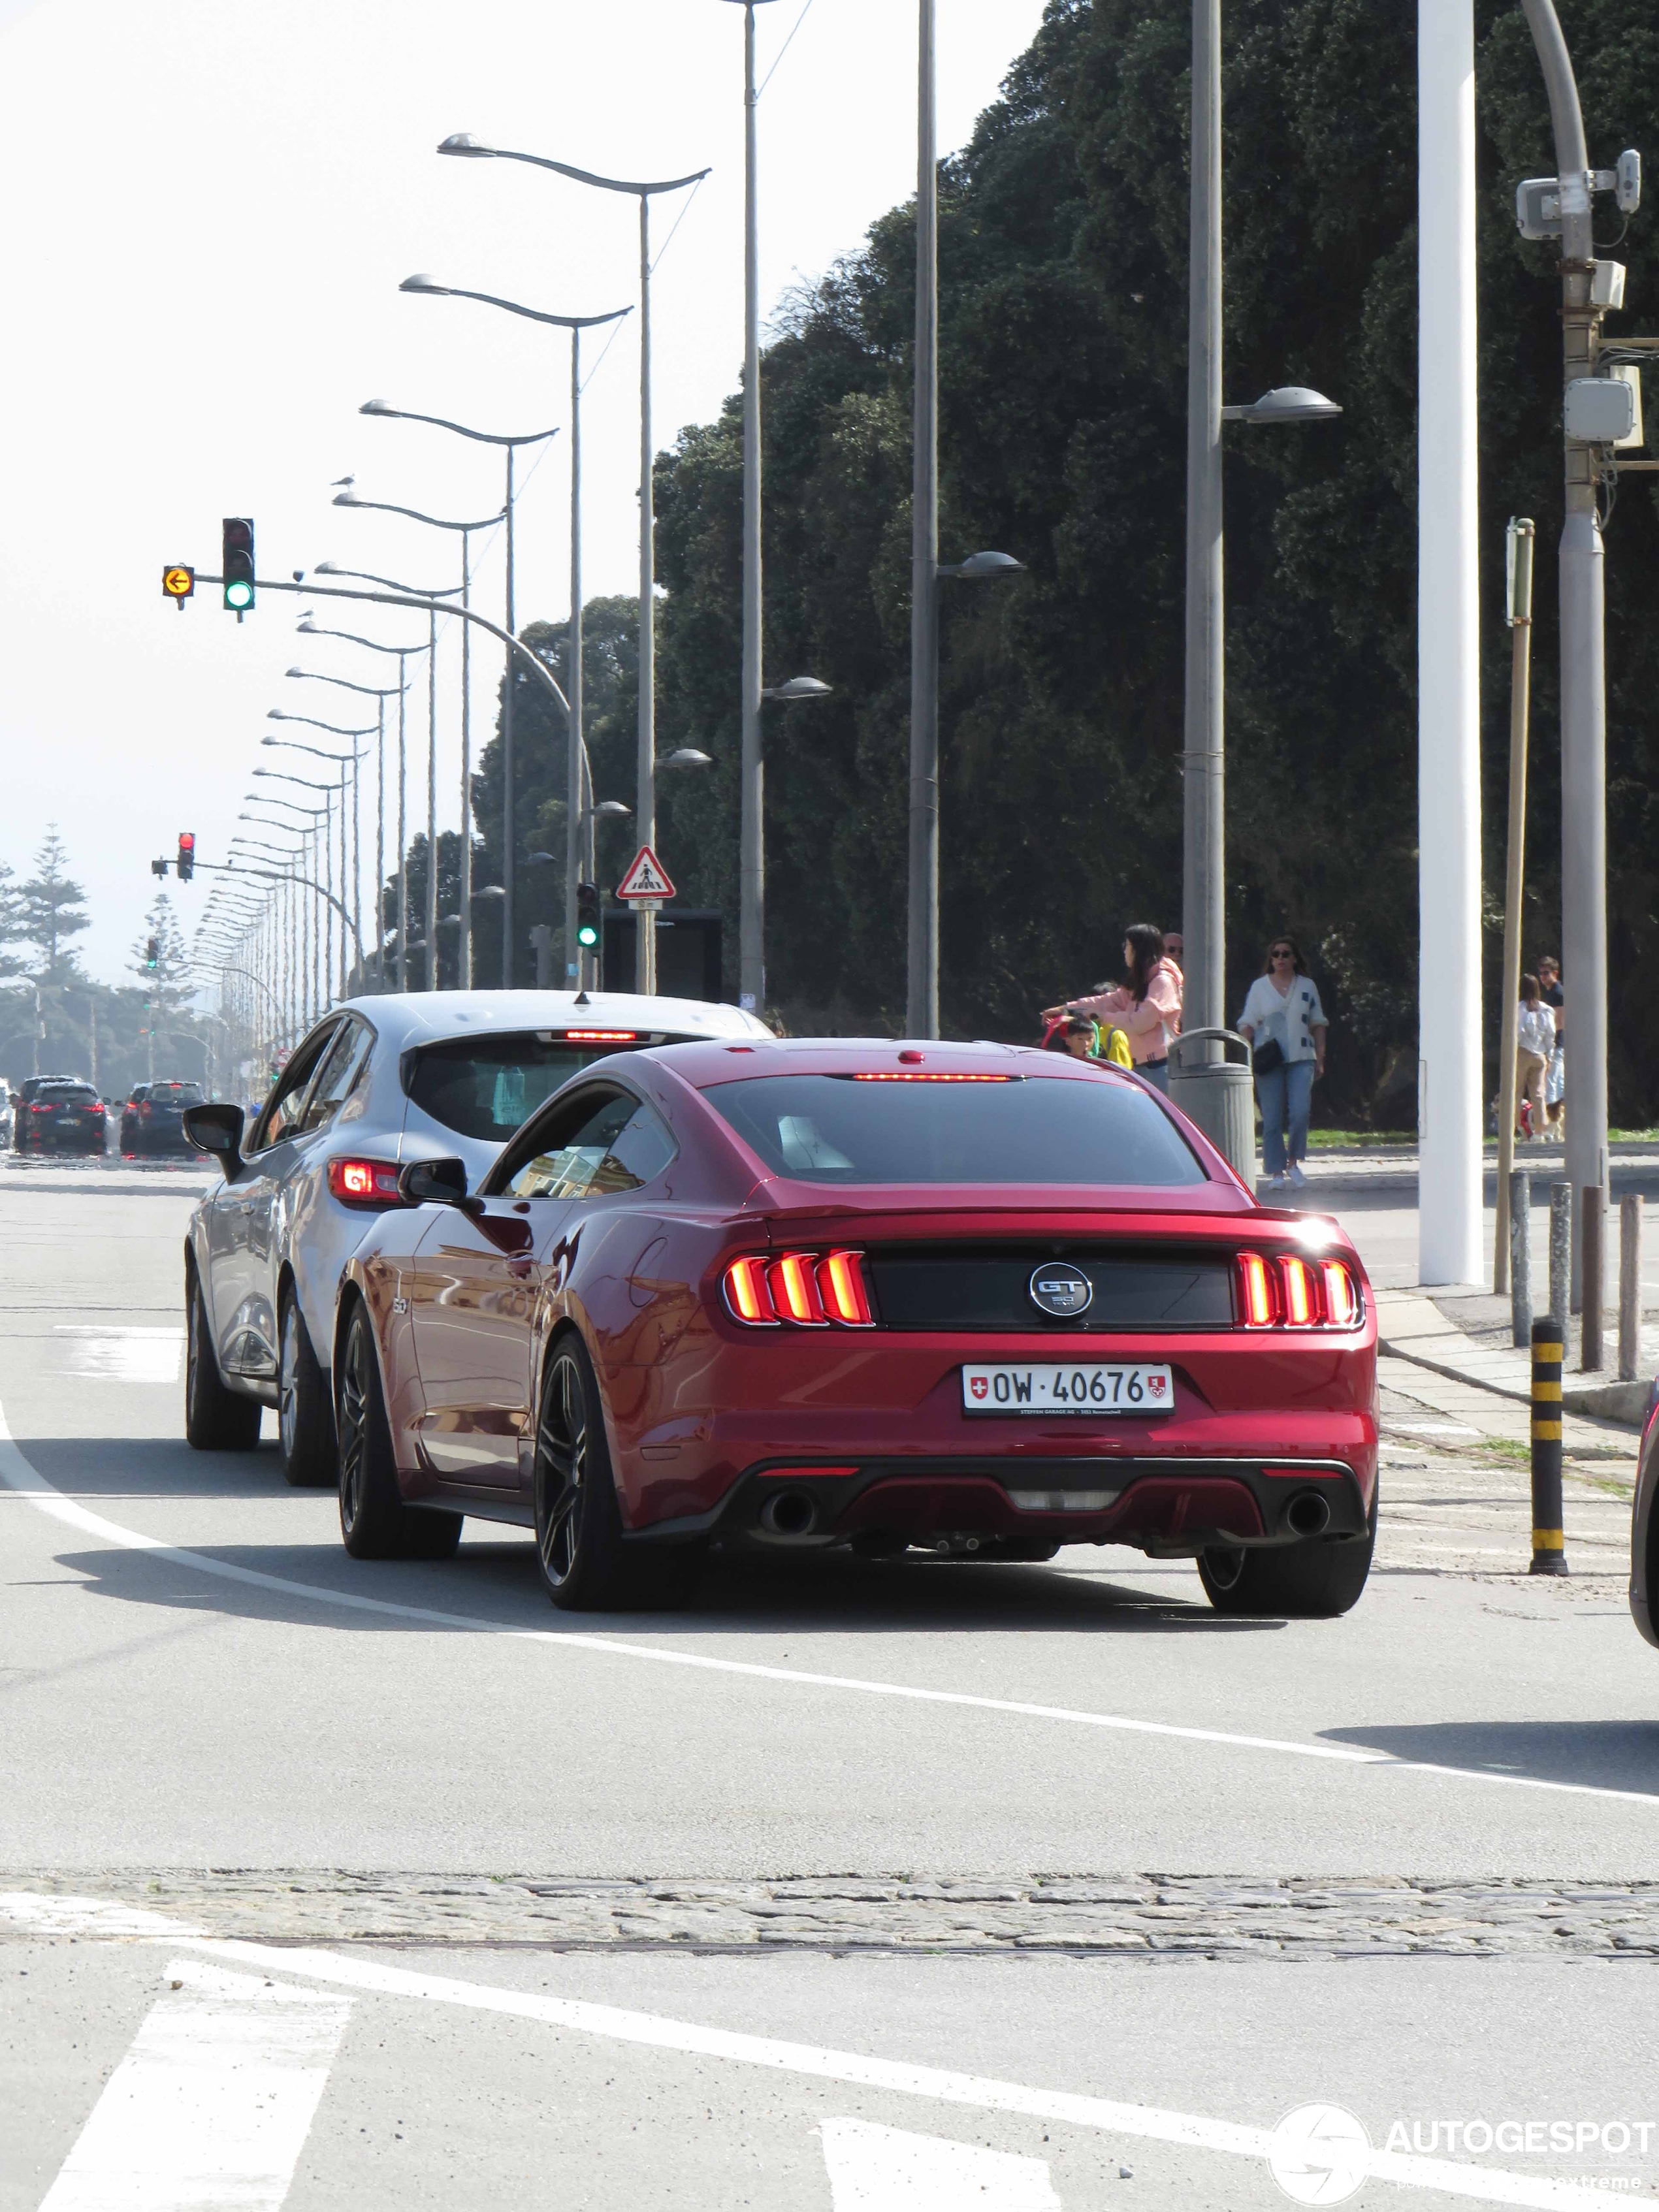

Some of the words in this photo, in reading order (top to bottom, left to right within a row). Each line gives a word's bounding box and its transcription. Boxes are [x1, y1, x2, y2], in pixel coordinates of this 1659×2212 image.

[1038, 1281, 1083, 1293] GT
[993, 1372, 1032, 1402] OW
[1053, 1371, 1143, 1402] 40676
